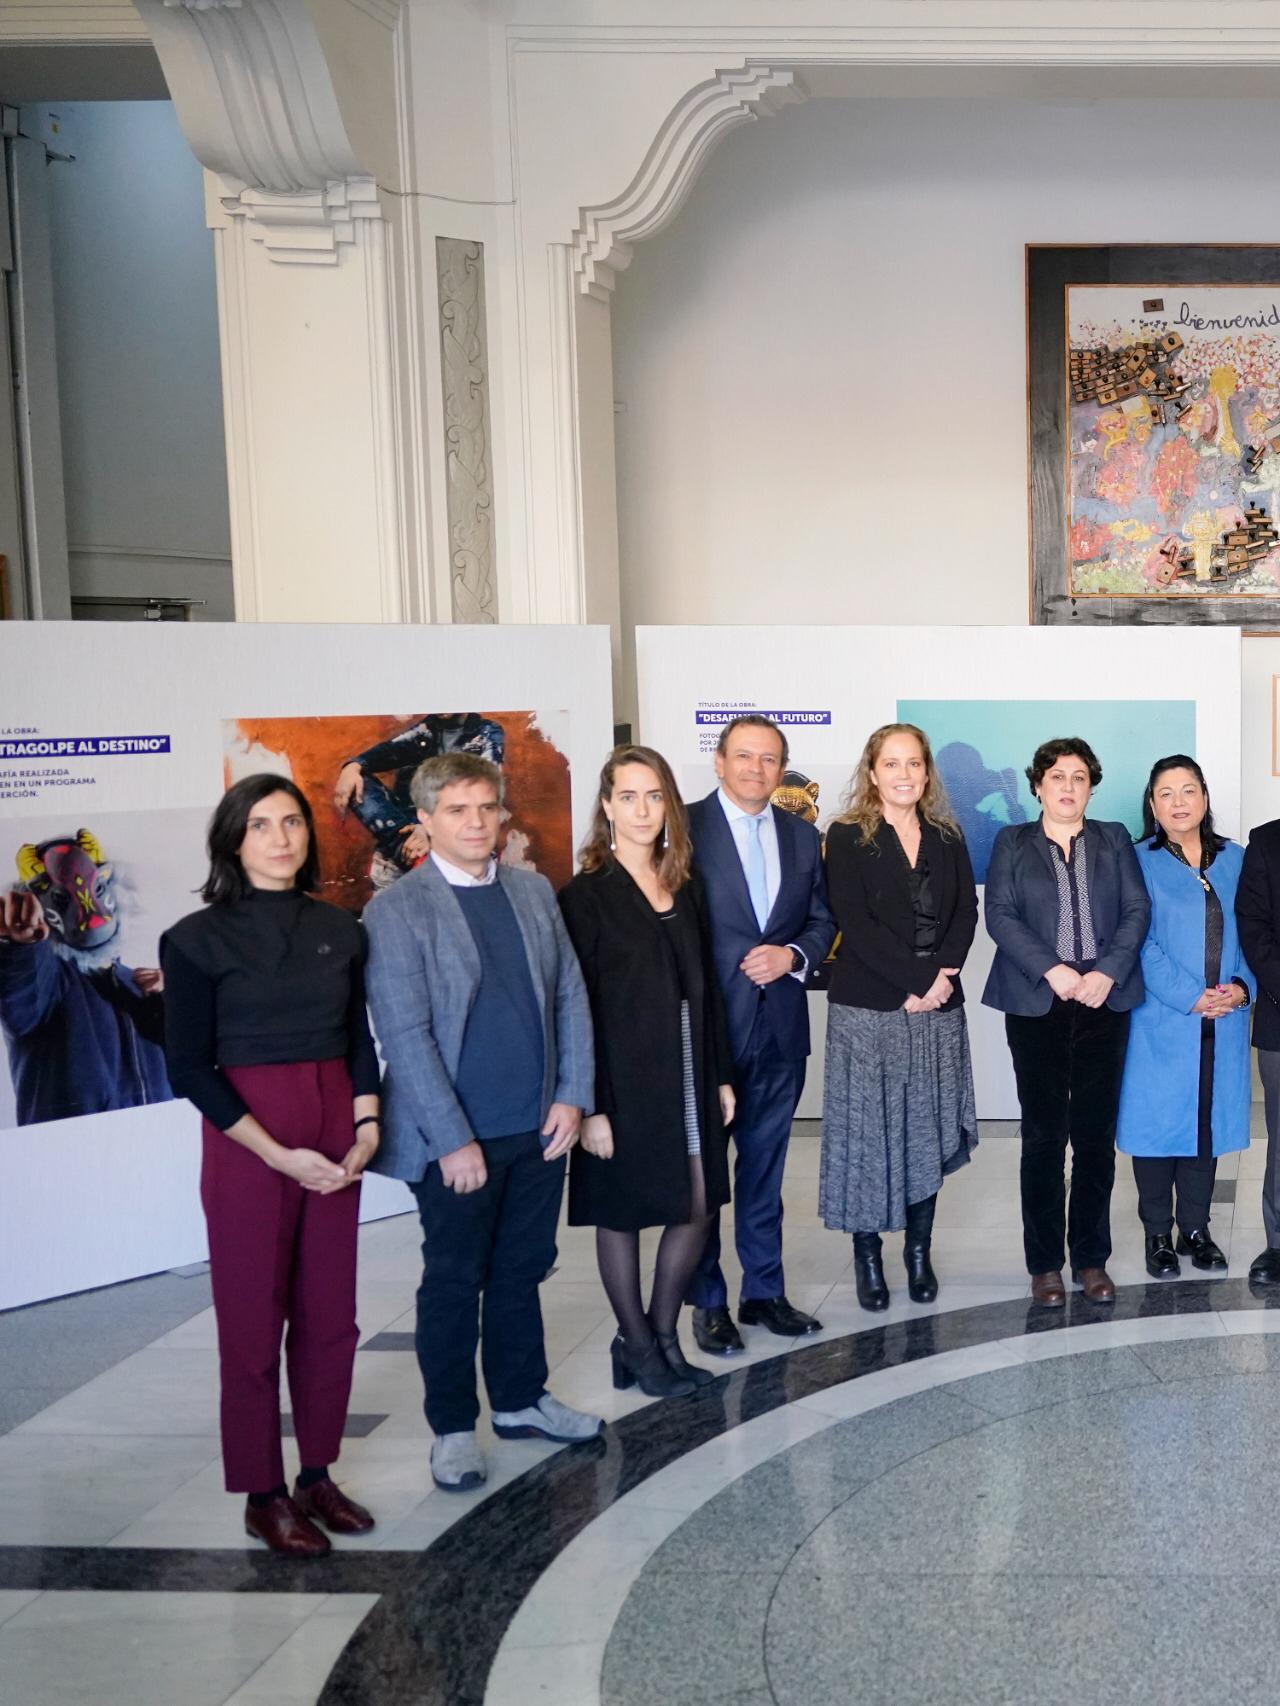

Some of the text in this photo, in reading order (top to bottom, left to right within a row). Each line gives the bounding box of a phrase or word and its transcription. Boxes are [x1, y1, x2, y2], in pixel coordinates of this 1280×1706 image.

[769, 713, 781, 722] AL
[78, 741, 97, 753] AL
[20, 769, 69, 777] REALIZADA
[44, 777, 96, 787] PROGRAMA
